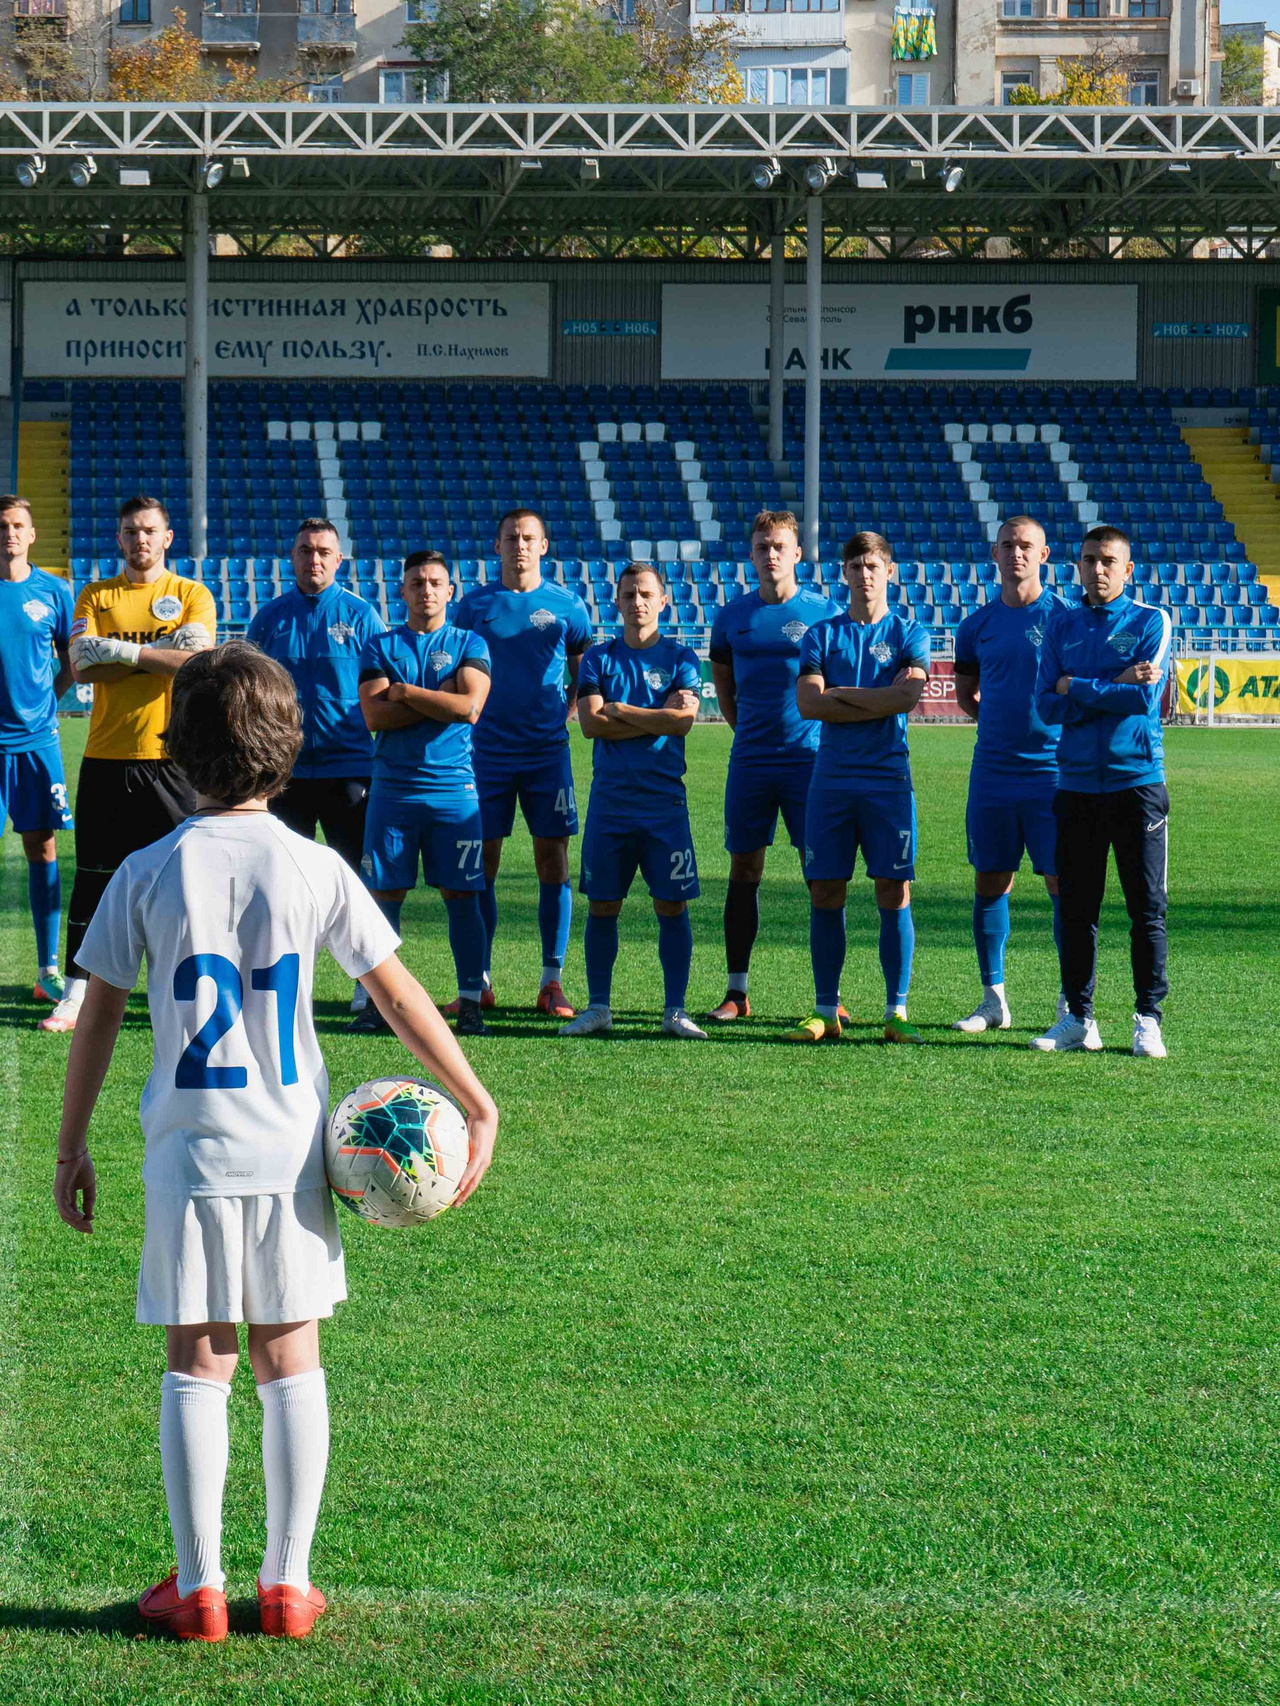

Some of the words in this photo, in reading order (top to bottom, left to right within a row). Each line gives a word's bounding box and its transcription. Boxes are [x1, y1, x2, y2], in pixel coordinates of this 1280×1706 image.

[66, 298, 81, 316] а
[356, 298, 508, 325] храбрость
[904, 294, 1033, 343] рнкб
[66, 339, 187, 366] приноси
[214, 340, 272, 367] ему
[282, 340, 392, 367] пользу.
[457, 840, 483, 869] 77
[899, 830, 911, 859] 7
[670, 849, 695, 880] 22
[173, 953, 300, 1090] 21
